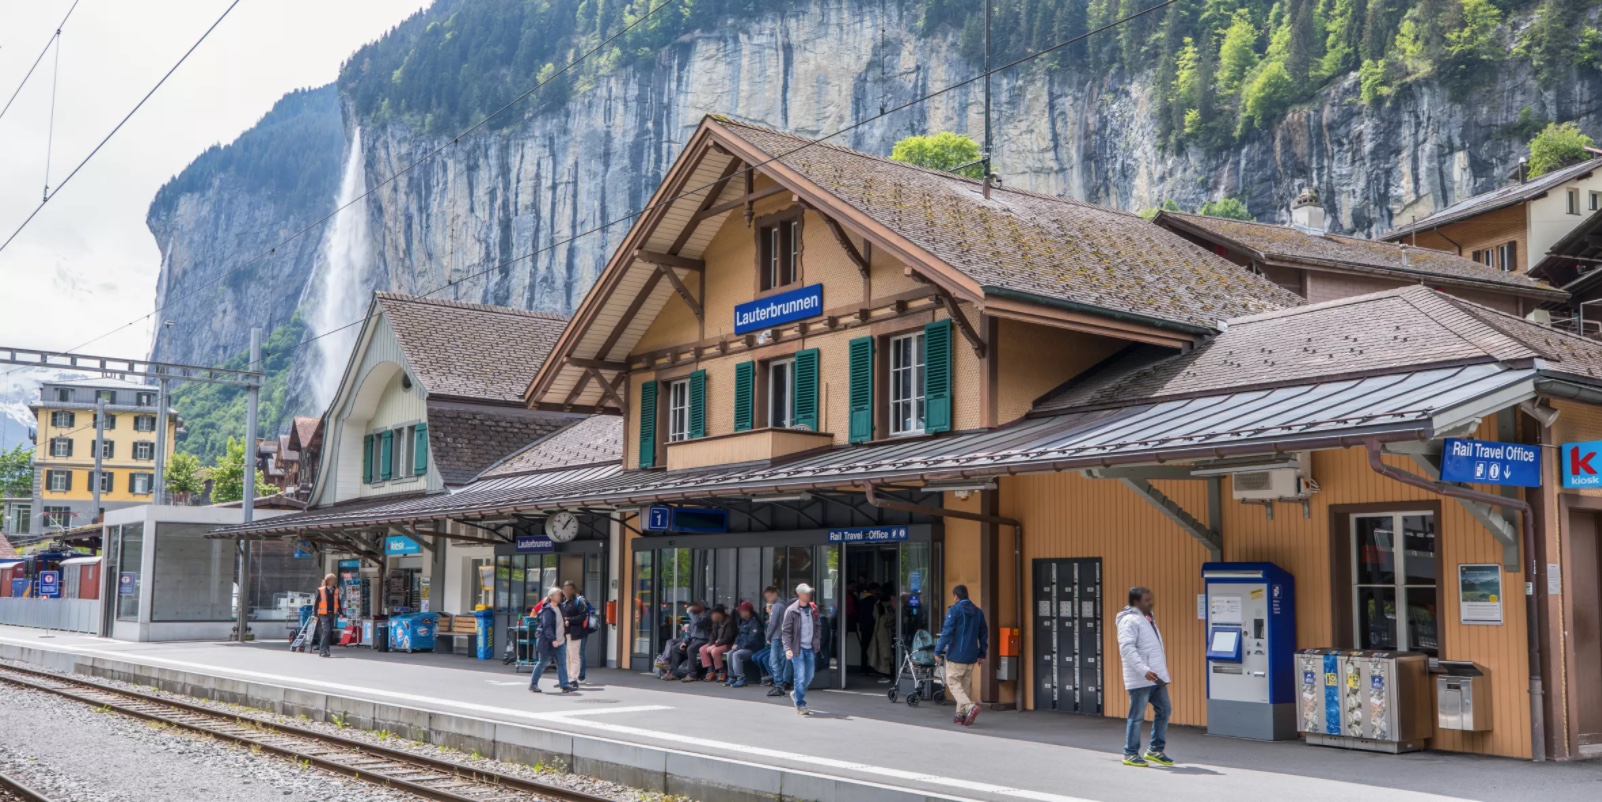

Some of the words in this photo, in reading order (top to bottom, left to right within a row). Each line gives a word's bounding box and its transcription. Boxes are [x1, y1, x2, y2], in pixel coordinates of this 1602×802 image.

[736, 294, 819, 327] Lauterbrunnen
[1452, 441, 1473, 457] Rail
[1474, 443, 1504, 460] Travel
[1505, 445, 1535, 462] Office
[1571, 476, 1599, 485] kiosk
[656, 513, 662, 526] 1
[829, 532, 842, 541] Rail
[843, 530, 863, 540] Travel
[868, 529, 889, 540] Office
[390, 540, 405, 551] kiosk
[517, 540, 552, 549] Lauterbrunnen
